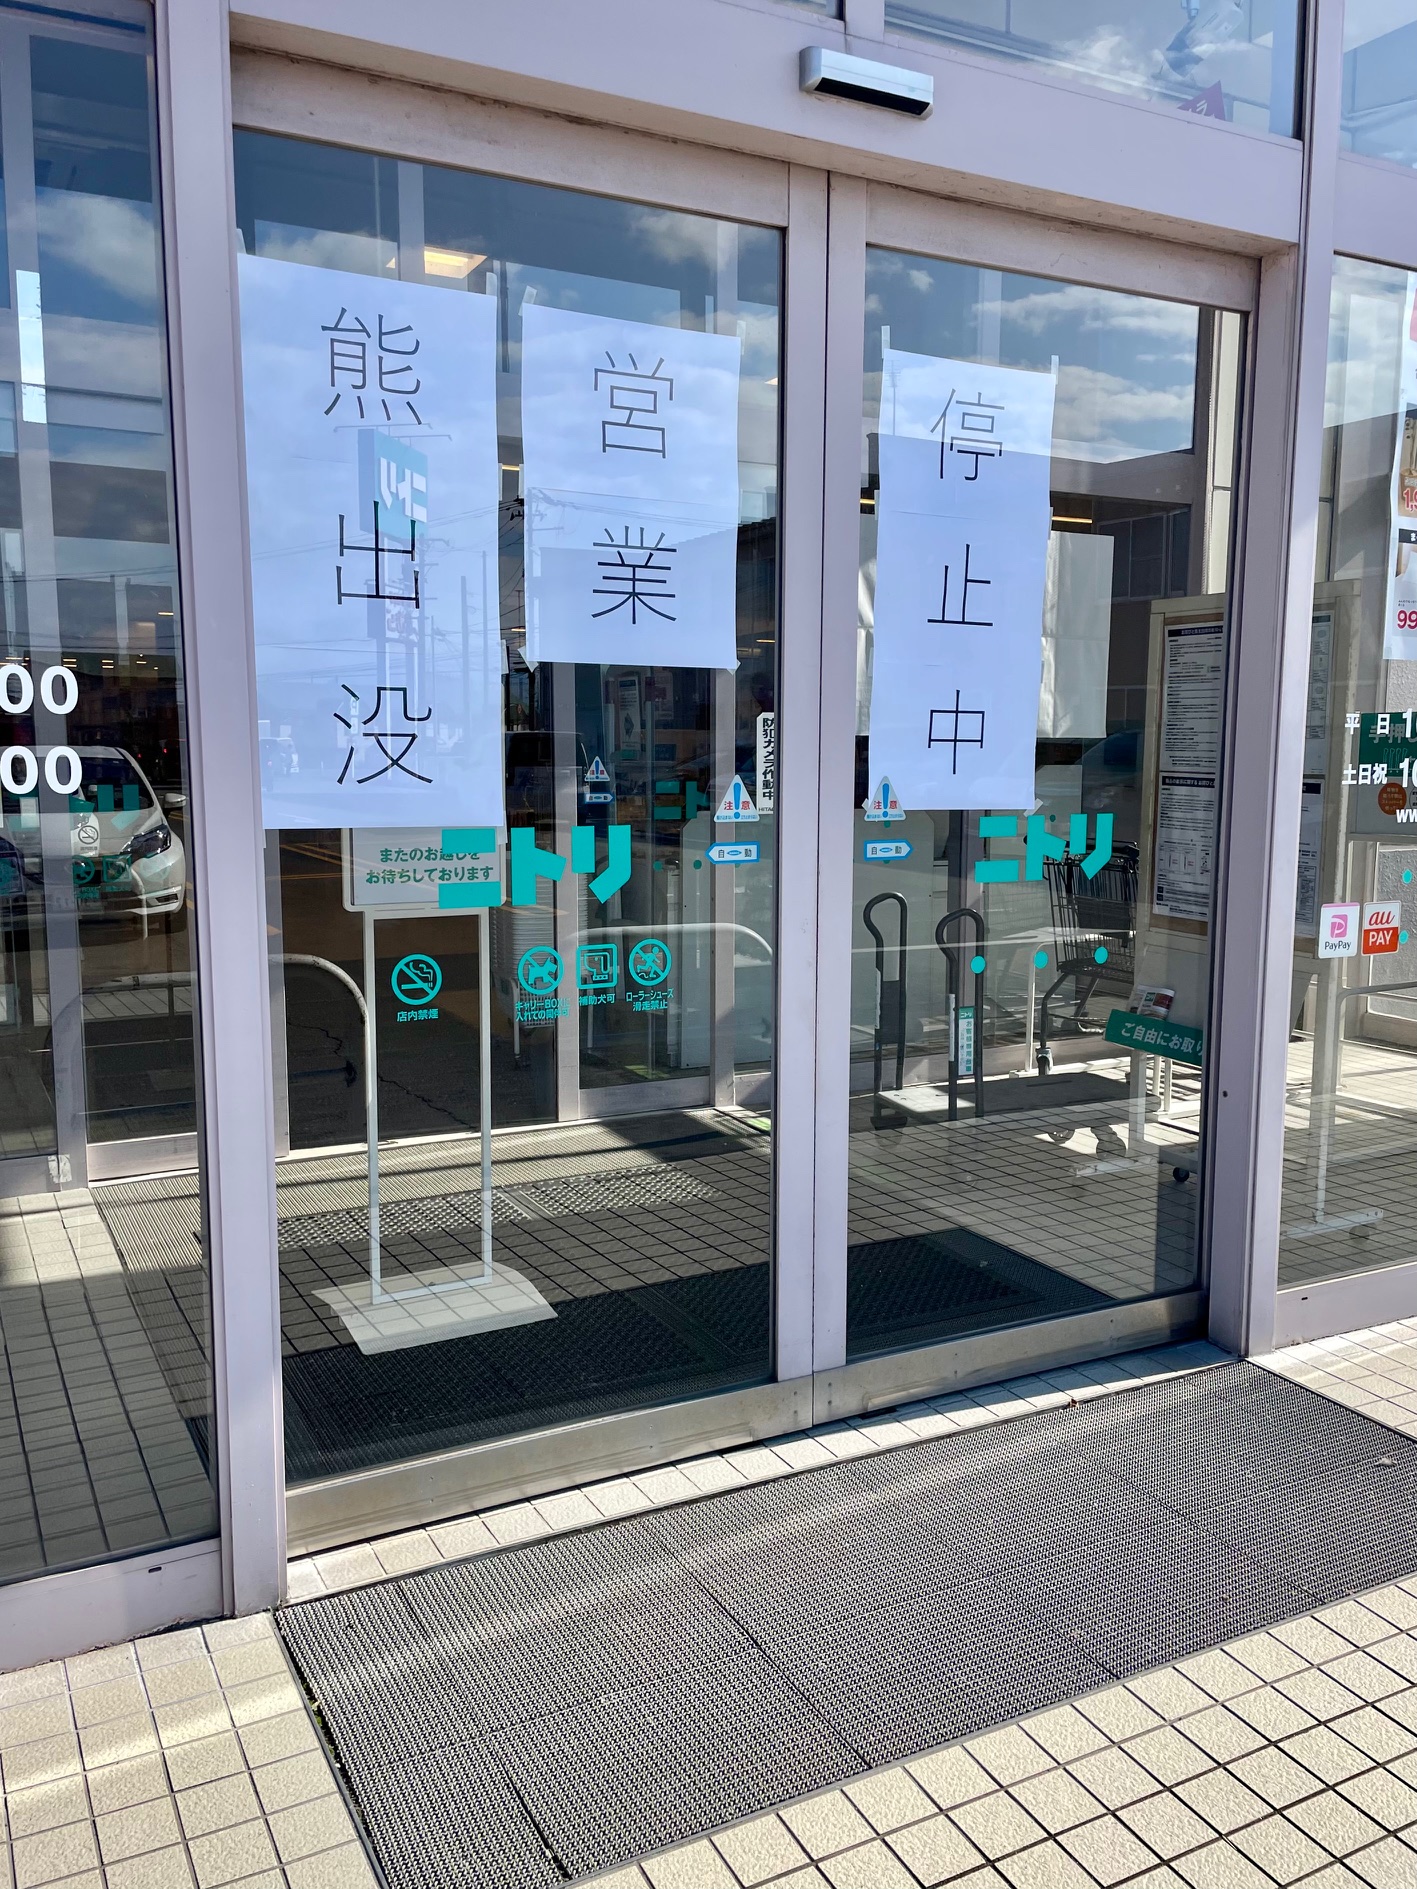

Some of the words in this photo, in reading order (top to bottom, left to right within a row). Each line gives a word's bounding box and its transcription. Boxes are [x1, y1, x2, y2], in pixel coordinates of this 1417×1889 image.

[591, 350, 677, 625] 営業
[320, 307, 433, 786] 熊出没
[928, 388, 1004, 775] 停止中
[0, 664, 79, 715] 00
[1345, 713, 1391, 735] 平日
[1402, 708, 1417, 738] 1
[0, 745, 83, 795] 00
[1342, 763, 1388, 785] 土日祝
[975, 813, 1113, 883] ニトリ
[366, 866, 493, 884] お待ちしております
[438, 825, 632, 909] ニトリ
[1368, 911, 1395, 926] au
[1324, 940, 1352, 951] PayPay
[1369, 930, 1393, 946] PAY
[626, 988, 674, 1002] ローラーシューズ
[397, 1008, 439, 1022] 店内禁煙
